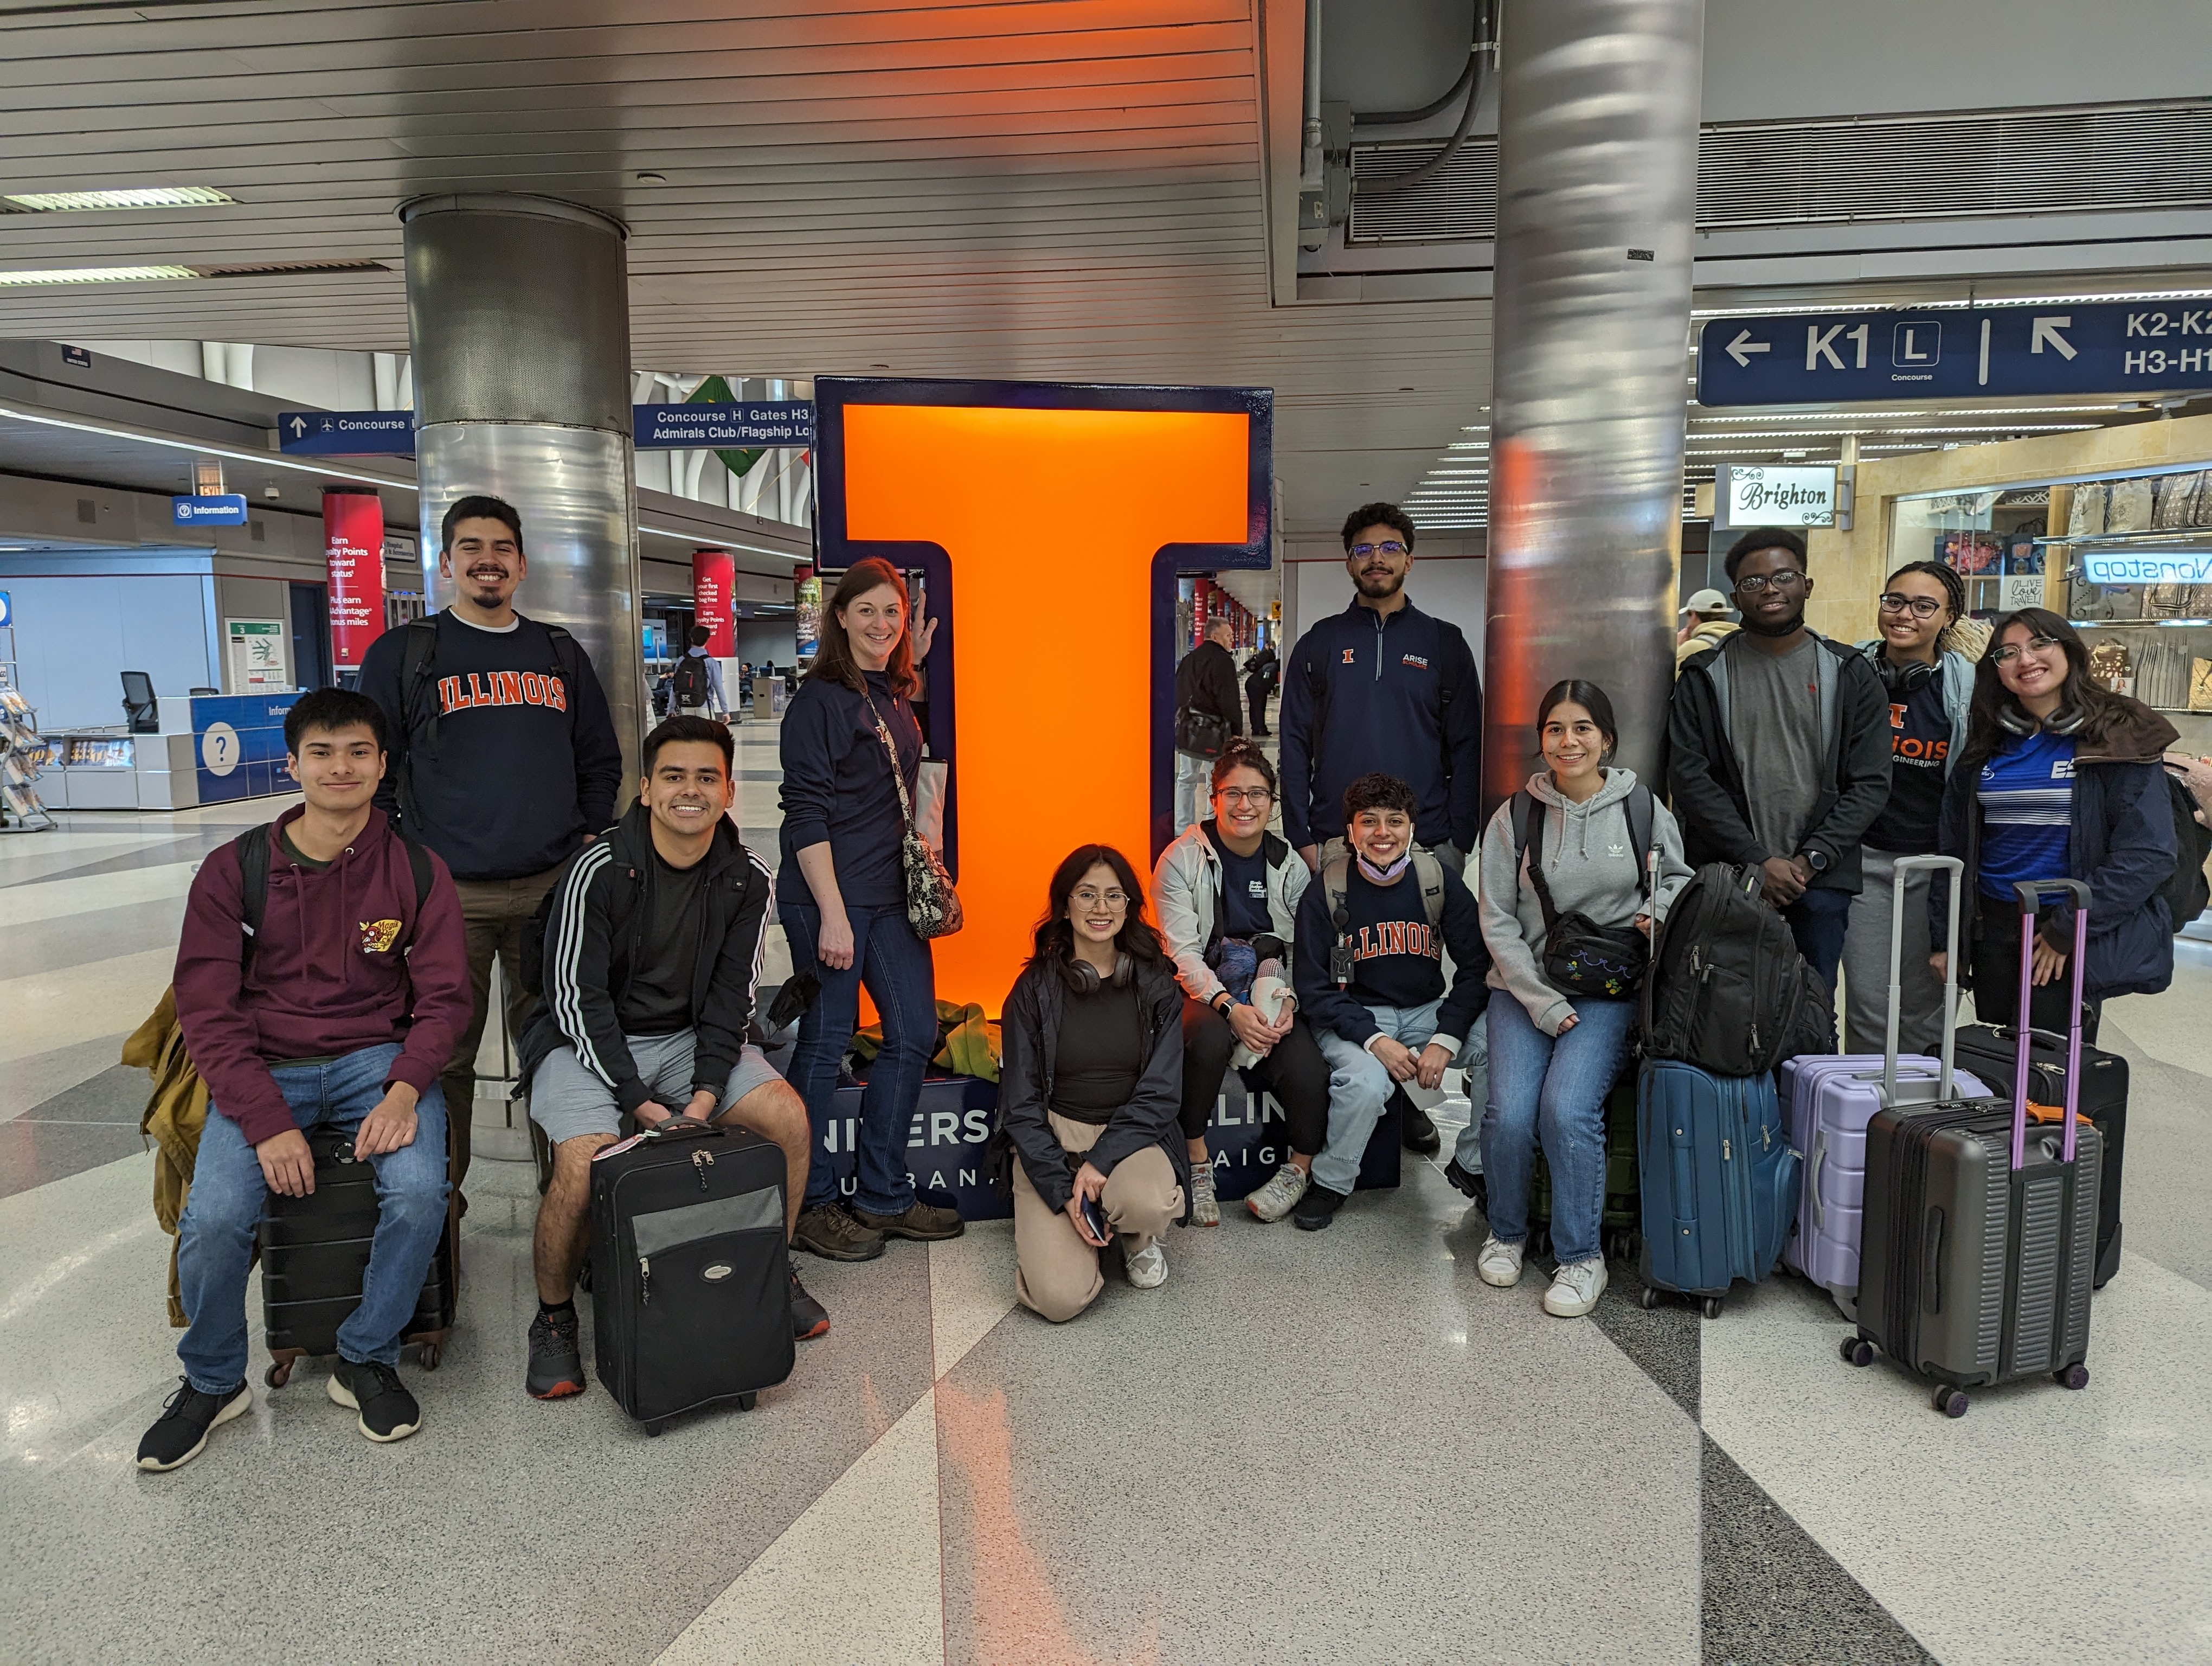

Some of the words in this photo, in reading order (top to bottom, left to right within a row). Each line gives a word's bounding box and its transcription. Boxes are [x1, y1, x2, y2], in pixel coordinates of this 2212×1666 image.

[1806, 323, 1867, 370] K1
[1905, 330, 1927, 360] L
[657, 411, 726, 423] Concourse
[732, 409, 742, 421] H
[750, 409, 787, 421] Gates
[338, 419, 406, 431] Concourse
[653, 427, 705, 439] Admirals
[708, 425, 792, 440] Club/Flagship
[1738, 482, 1827, 510] Brighton
[194, 506, 240, 515] Information
[331, 536, 349, 544] Earn
[342, 547, 369, 556] Points
[2011, 580, 2041, 596] love
[2018, 579, 2042, 587] LIVE
[346, 617, 369, 626] miles
[1403, 653, 1429, 666] ARISE
[438, 670, 567, 715] ILLINOIS
[377, 920, 399, 931] Magik
